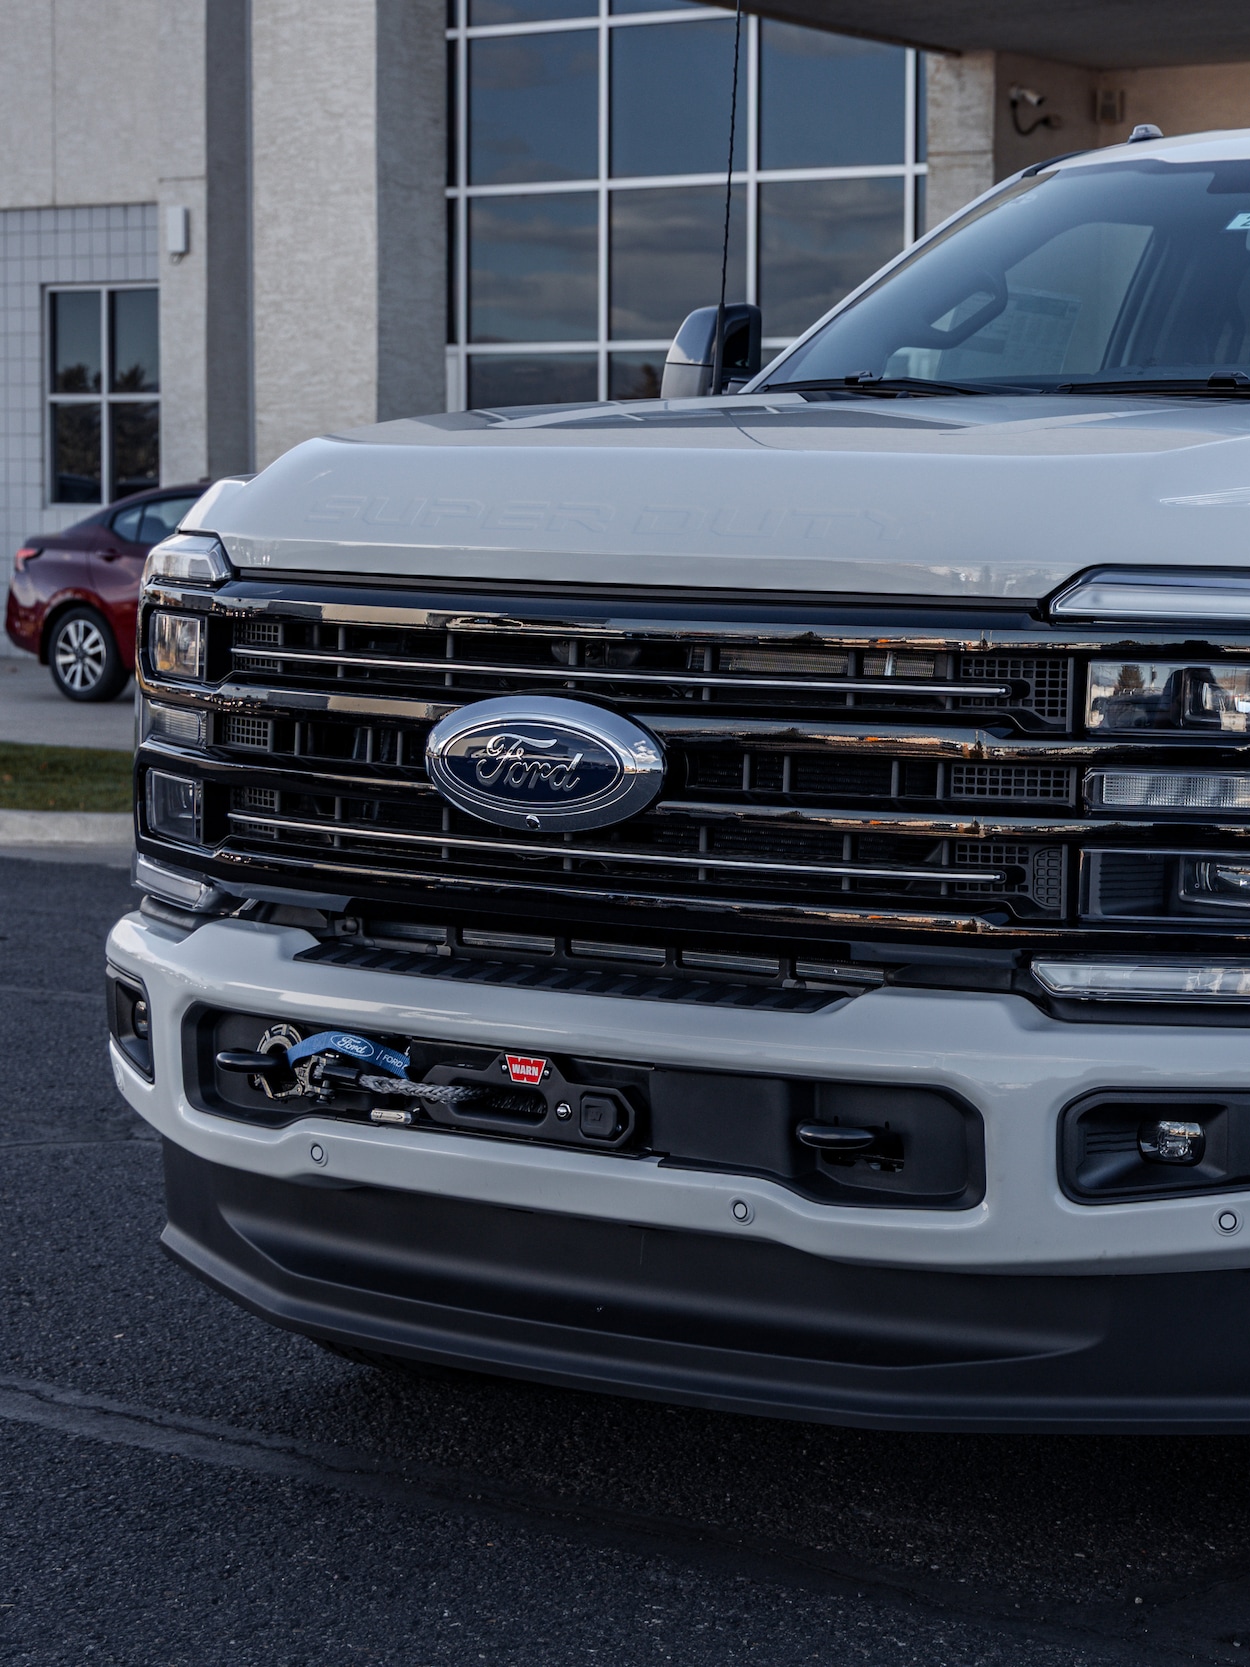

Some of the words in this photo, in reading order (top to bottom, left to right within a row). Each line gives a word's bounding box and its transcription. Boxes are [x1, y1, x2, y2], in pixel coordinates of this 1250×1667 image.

[304, 495, 616, 534] SUPER
[631, 503, 934, 542] DUTY
[476, 733, 584, 791] Ford
[336, 1036, 368, 1054] Ford
[382, 1054, 403, 1068] FORD
[511, 1063, 539, 1077] WARN
